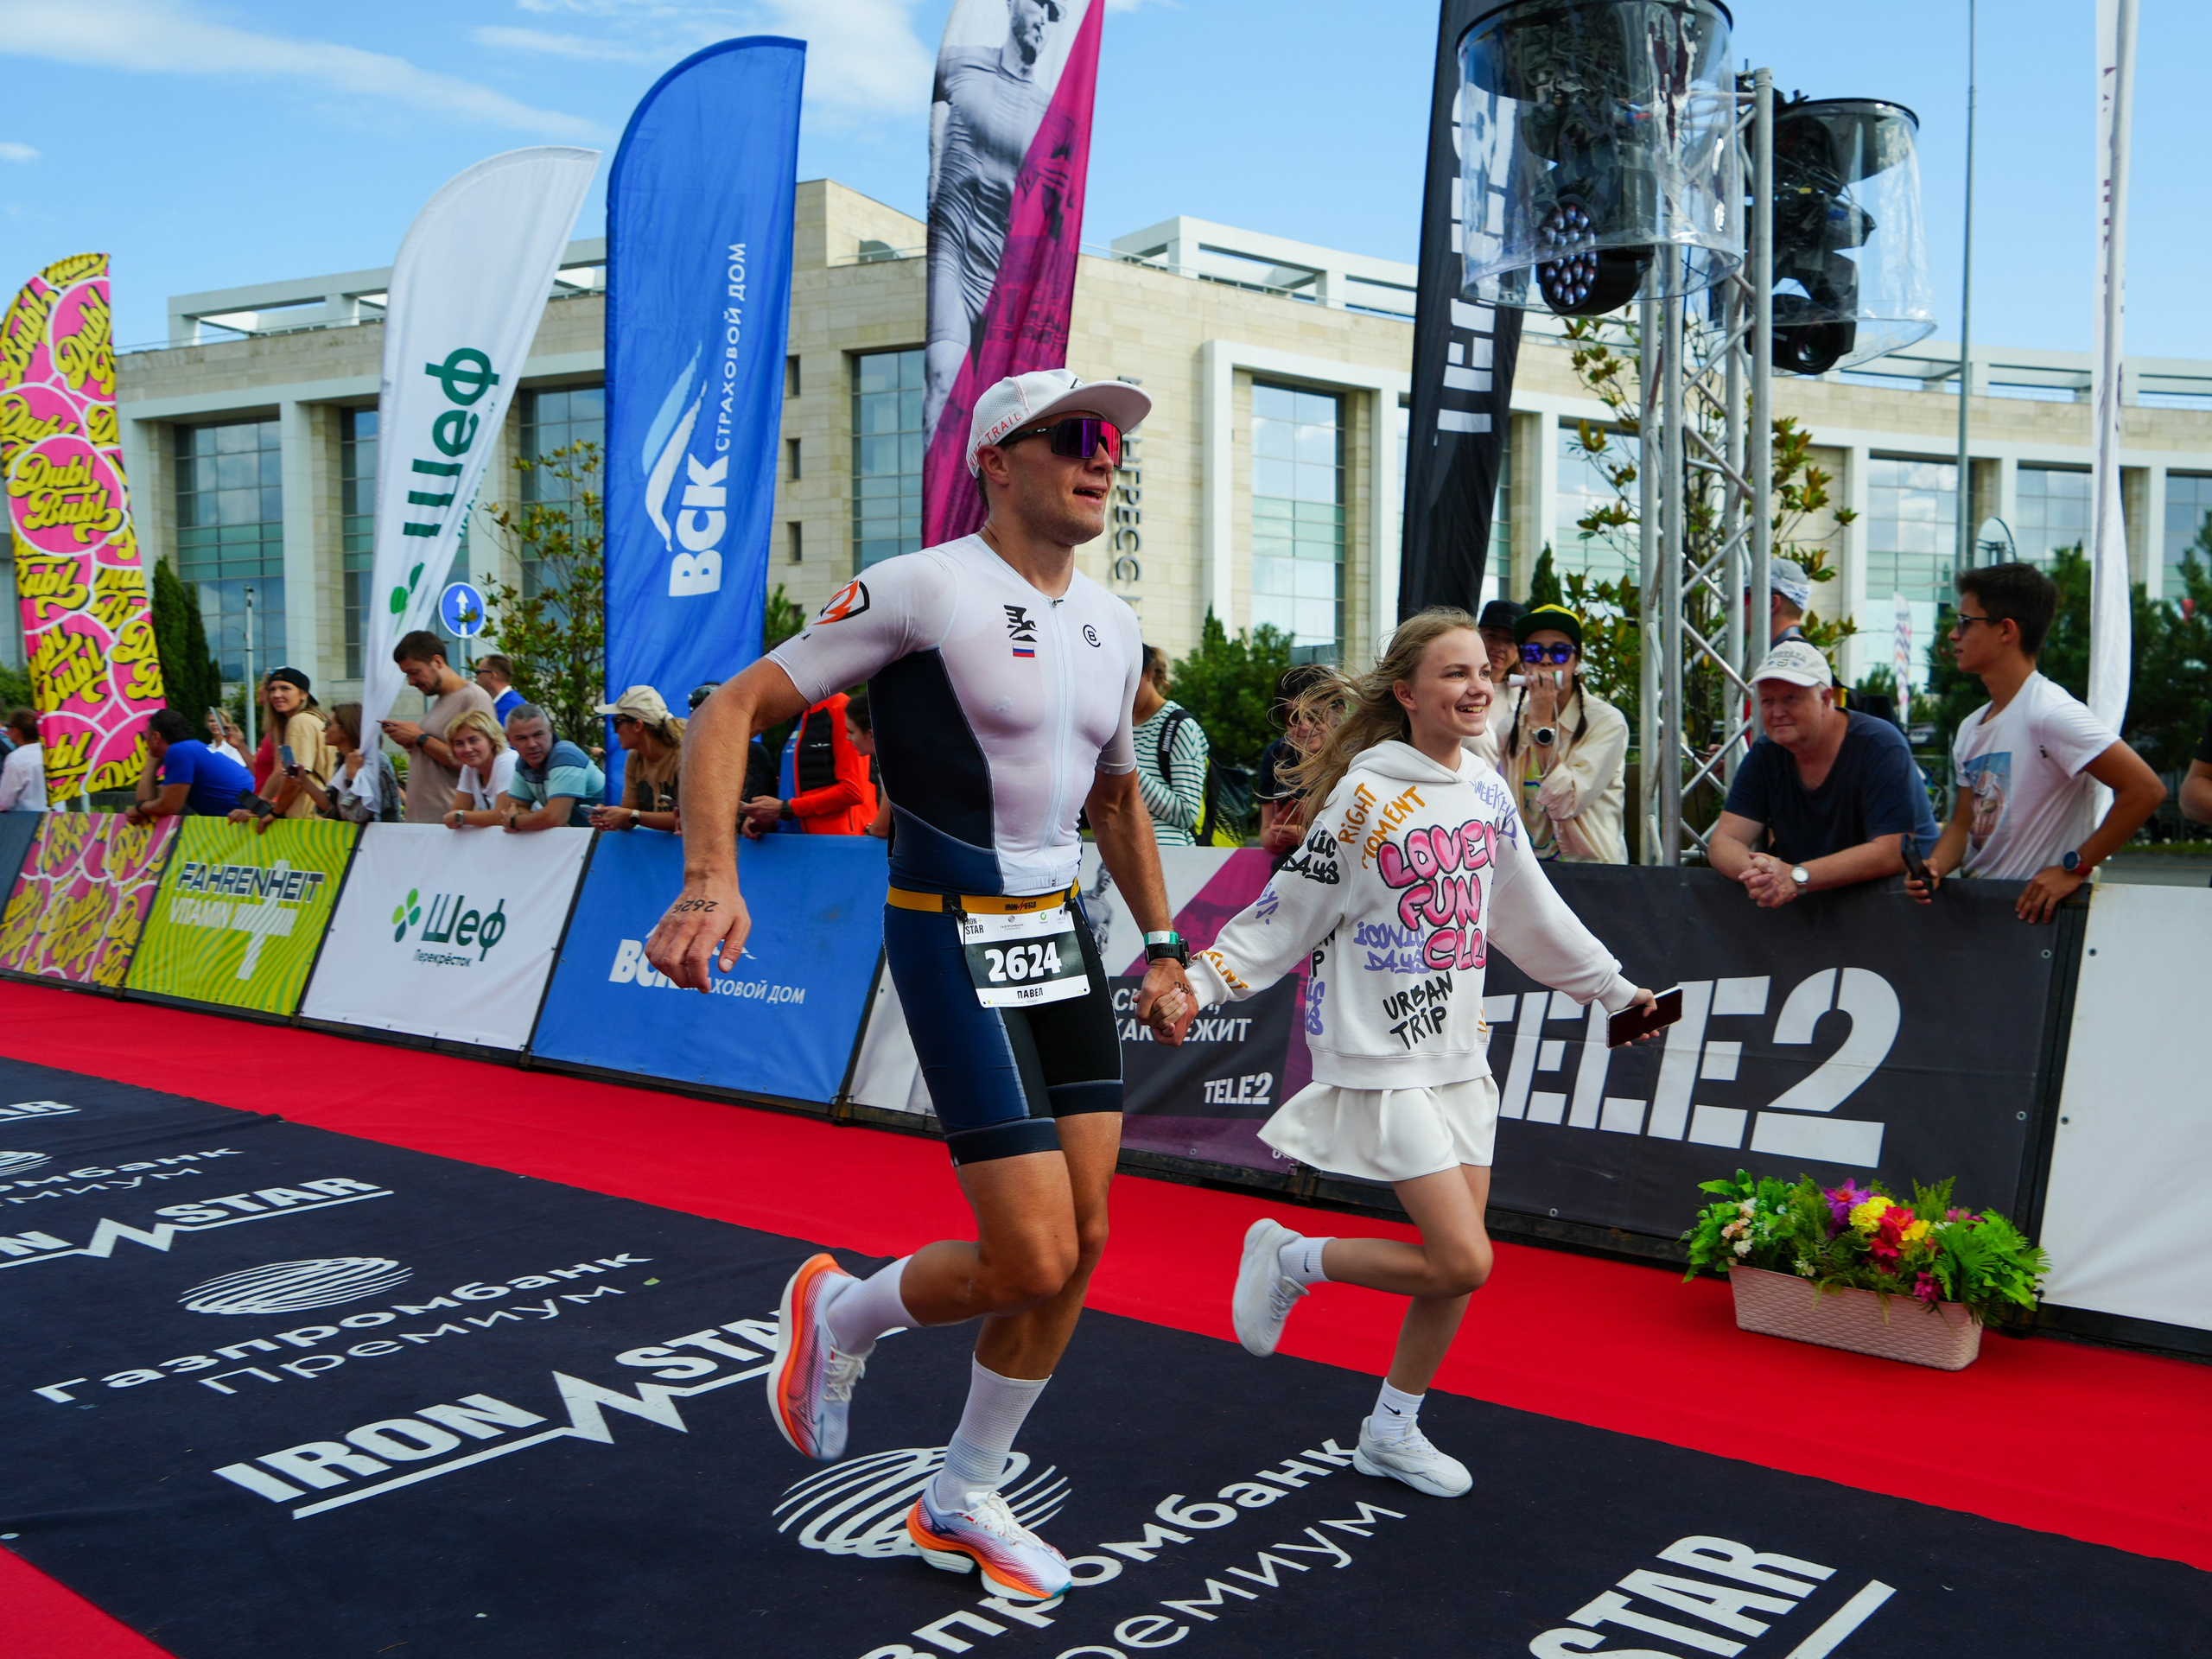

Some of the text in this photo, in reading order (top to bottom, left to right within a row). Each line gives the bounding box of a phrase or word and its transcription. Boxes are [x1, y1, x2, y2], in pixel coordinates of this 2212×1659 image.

[728, 243, 747, 301] ДОМ
[715, 308, 742, 451] СТРАХОВОЙ
[985, 412, 1023, 442] TRAIL
[7, 451, 101, 498] Dubl
[22, 488, 123, 543] Bubl
[175, 861, 326, 904] FAHRENHEIT
[1398, 873, 1482, 931] FUN
[169, 897, 233, 929] VITAMIN
[421, 893, 506, 962] Шеф
[965, 925, 984, 936] STAR
[985, 941, 1062, 982] 2624
[766, 985, 806, 1005] ДОМ
[1017, 987, 1044, 999] ПАВЕЛ
[1382, 971, 1453, 1020] URBAN
[1204, 1071, 1274, 1105] TELE2
[155, 1177, 382, 1224] STAR
[32, 1252, 654, 1404] Газпромбанк
[199, 1284, 626, 1395] Премиум
[212, 1393, 549, 1503] IRON
